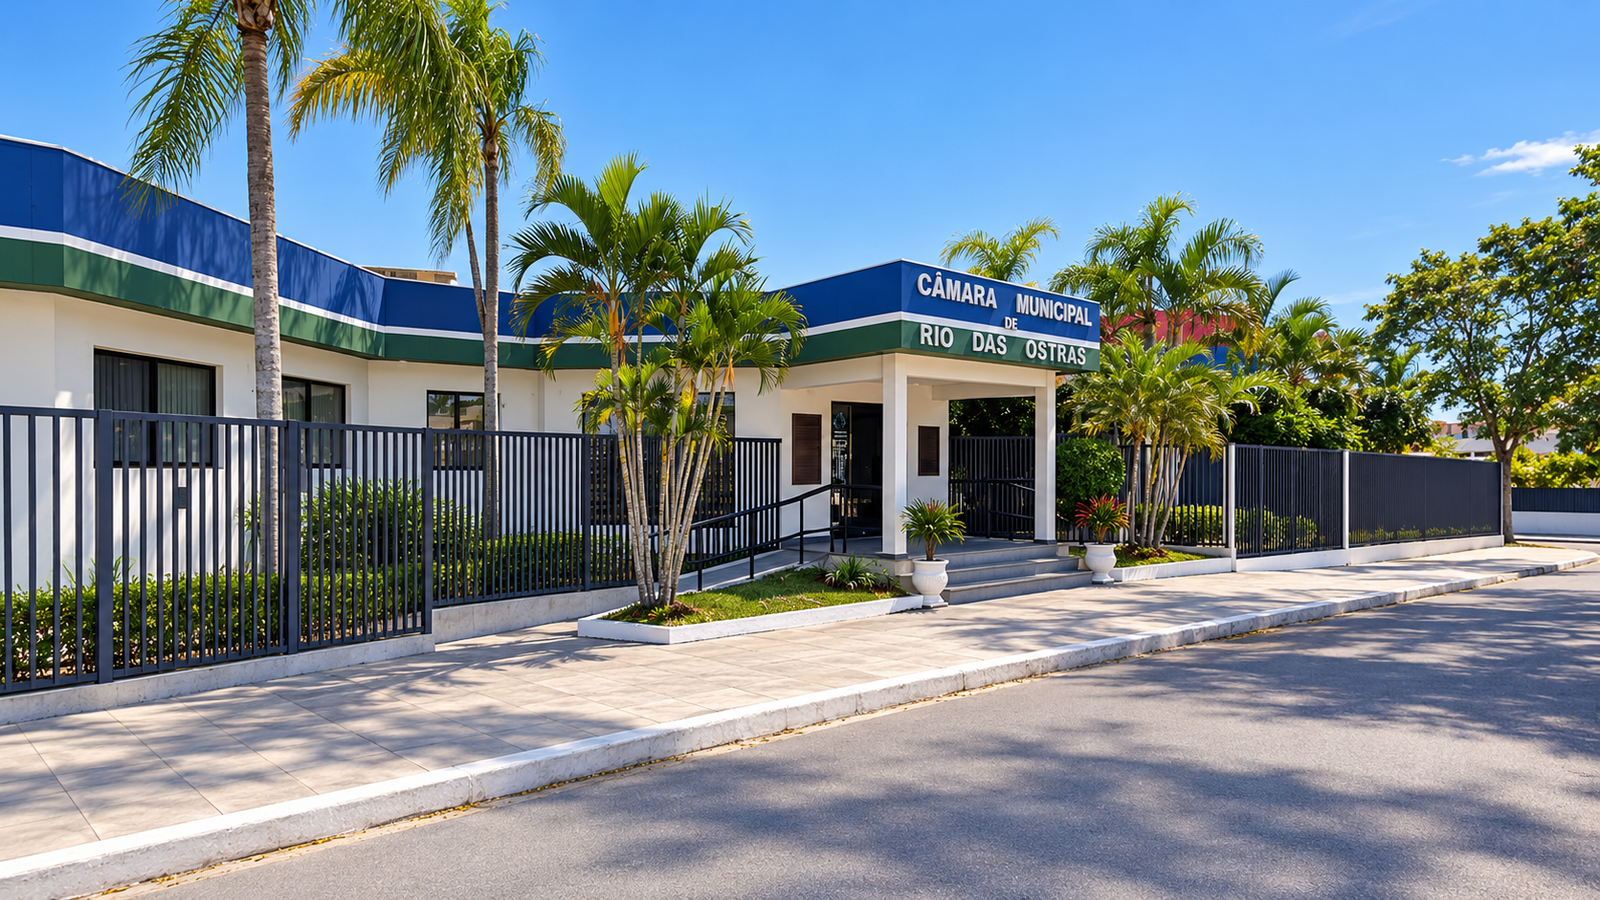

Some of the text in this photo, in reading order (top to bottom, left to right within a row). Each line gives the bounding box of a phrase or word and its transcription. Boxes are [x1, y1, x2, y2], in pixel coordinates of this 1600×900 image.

[917, 272, 1093, 327] CÂMARA MUNICIPAL
[920, 323, 1086, 366] RIO DAS OSTRAS
[1004, 316, 1018, 330] DE
